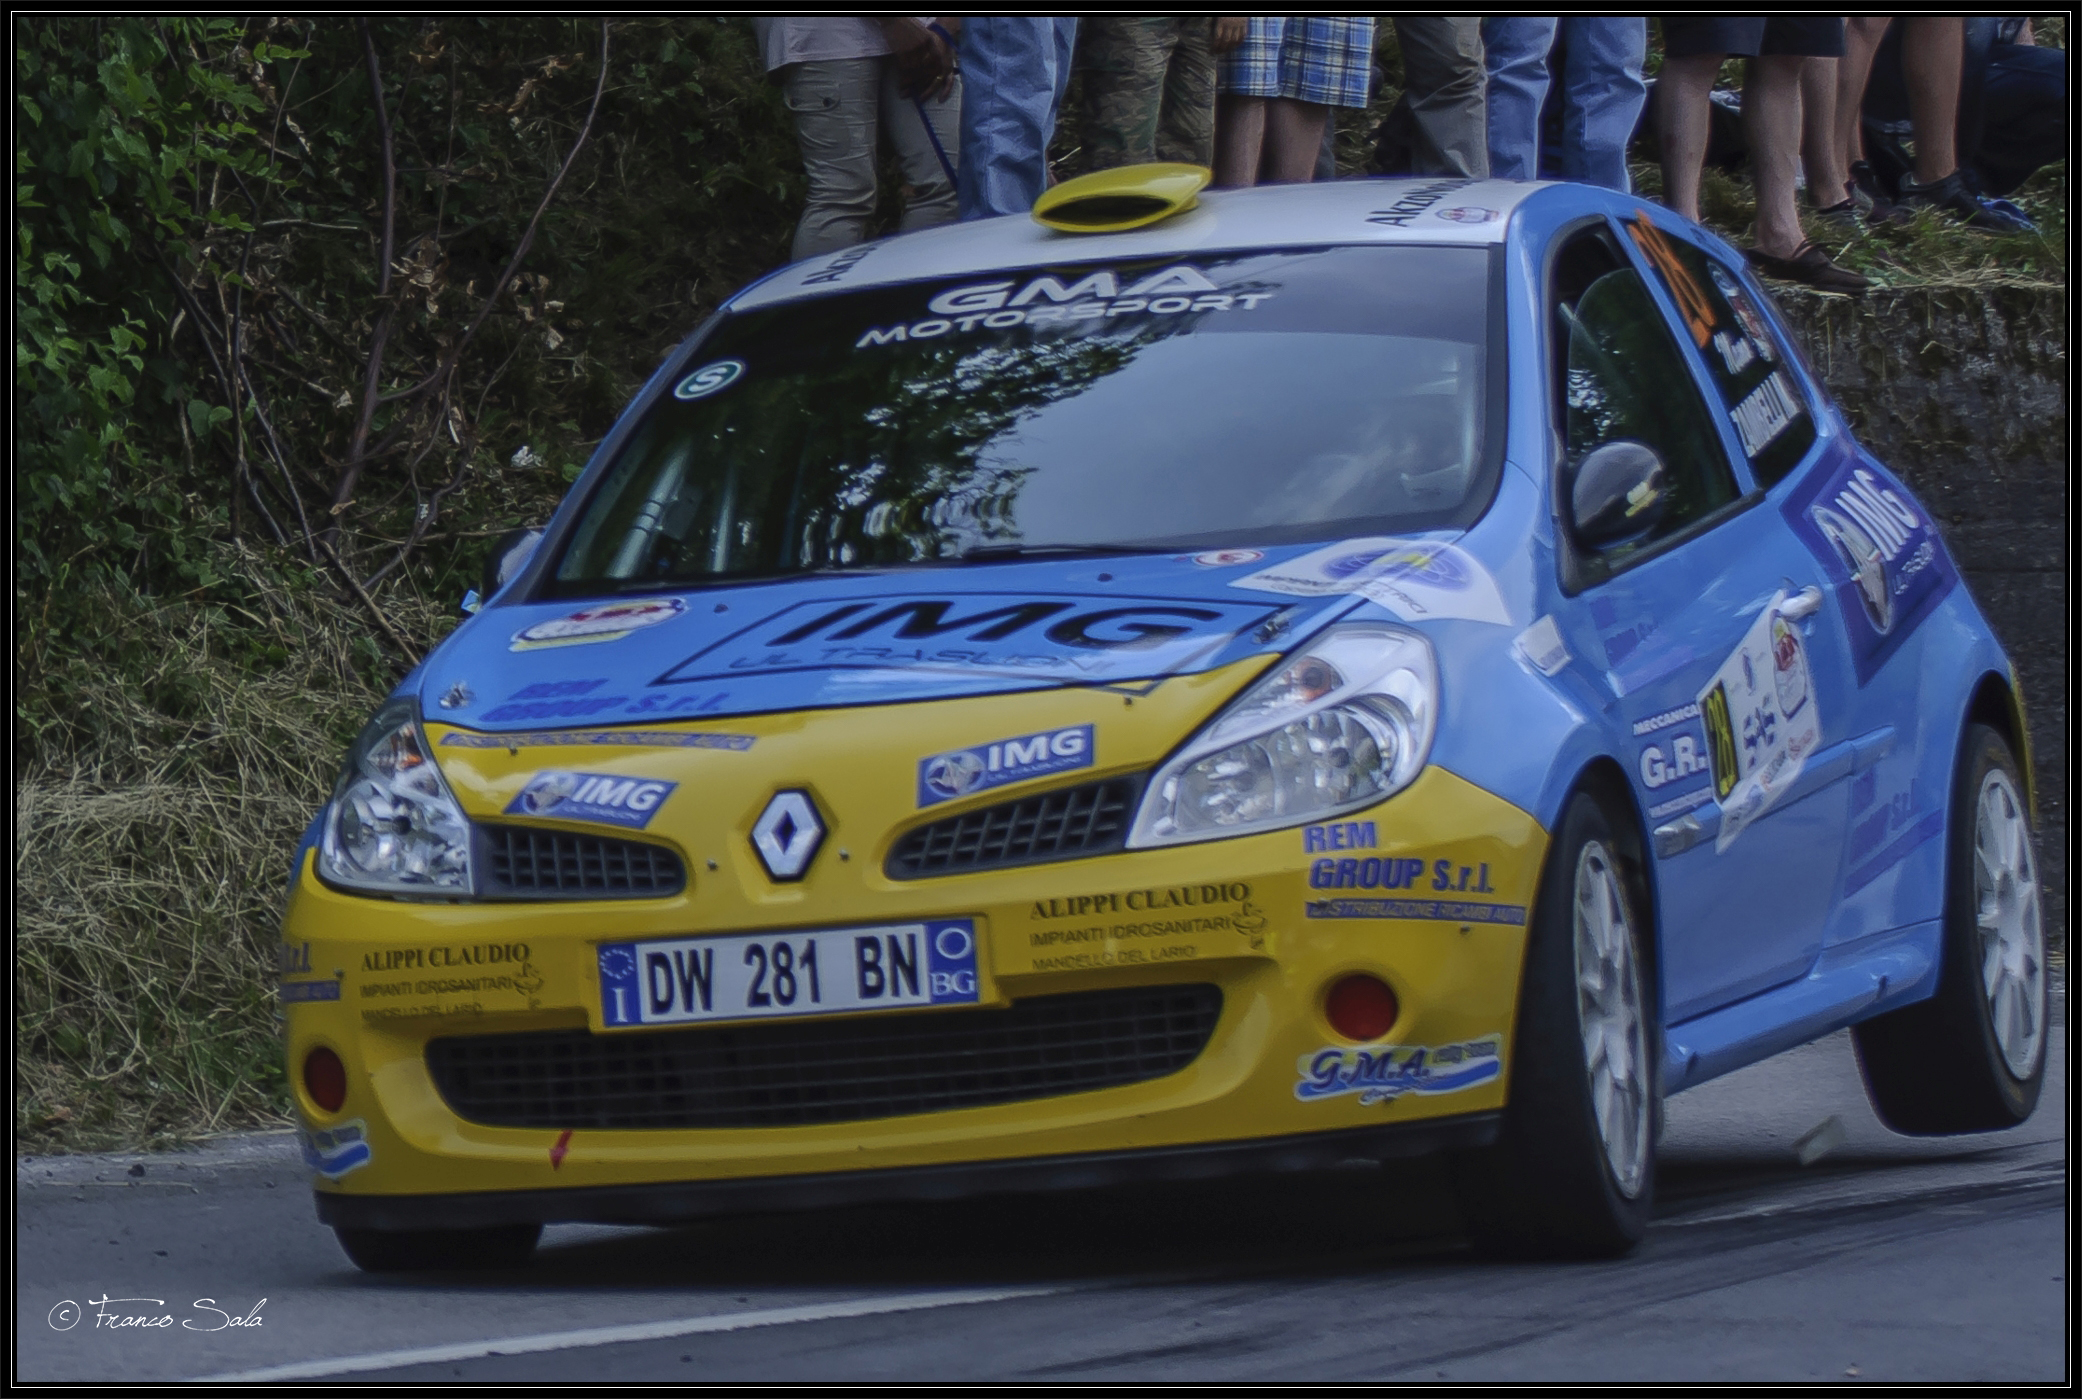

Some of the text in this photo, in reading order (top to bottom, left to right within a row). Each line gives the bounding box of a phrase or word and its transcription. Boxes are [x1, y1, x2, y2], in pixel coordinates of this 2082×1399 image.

[929, 266, 1219, 316] GMA
[855, 293, 1273, 348] MOTORSPORT
[688, 367, 728, 393] S
[1834, 469, 1920, 561] IMG
[764, 600, 1226, 648] IMG
[987, 729, 1085, 771] IMG
[1640, 736, 1709, 788] G.R.
[572, 777, 666, 811] IMG
[1303, 821, 1376, 853] REM
[1309, 858, 1494, 893] GROUP S.r.l.
[1030, 883, 1253, 920] ALIPPI CLAUDIO
[1030, 916, 1232, 947] IMPIANTI IDROSANITARI
[362, 943, 532, 972] ALIPPI CLAUDIO
[645, 933, 920, 1016] DW 281 BN
[360, 981, 412, 998] IMPIANTI
[930, 970, 975, 996] BG
[613, 987, 628, 1022] I
[1311, 1048, 1430, 1089] G.M.A.
